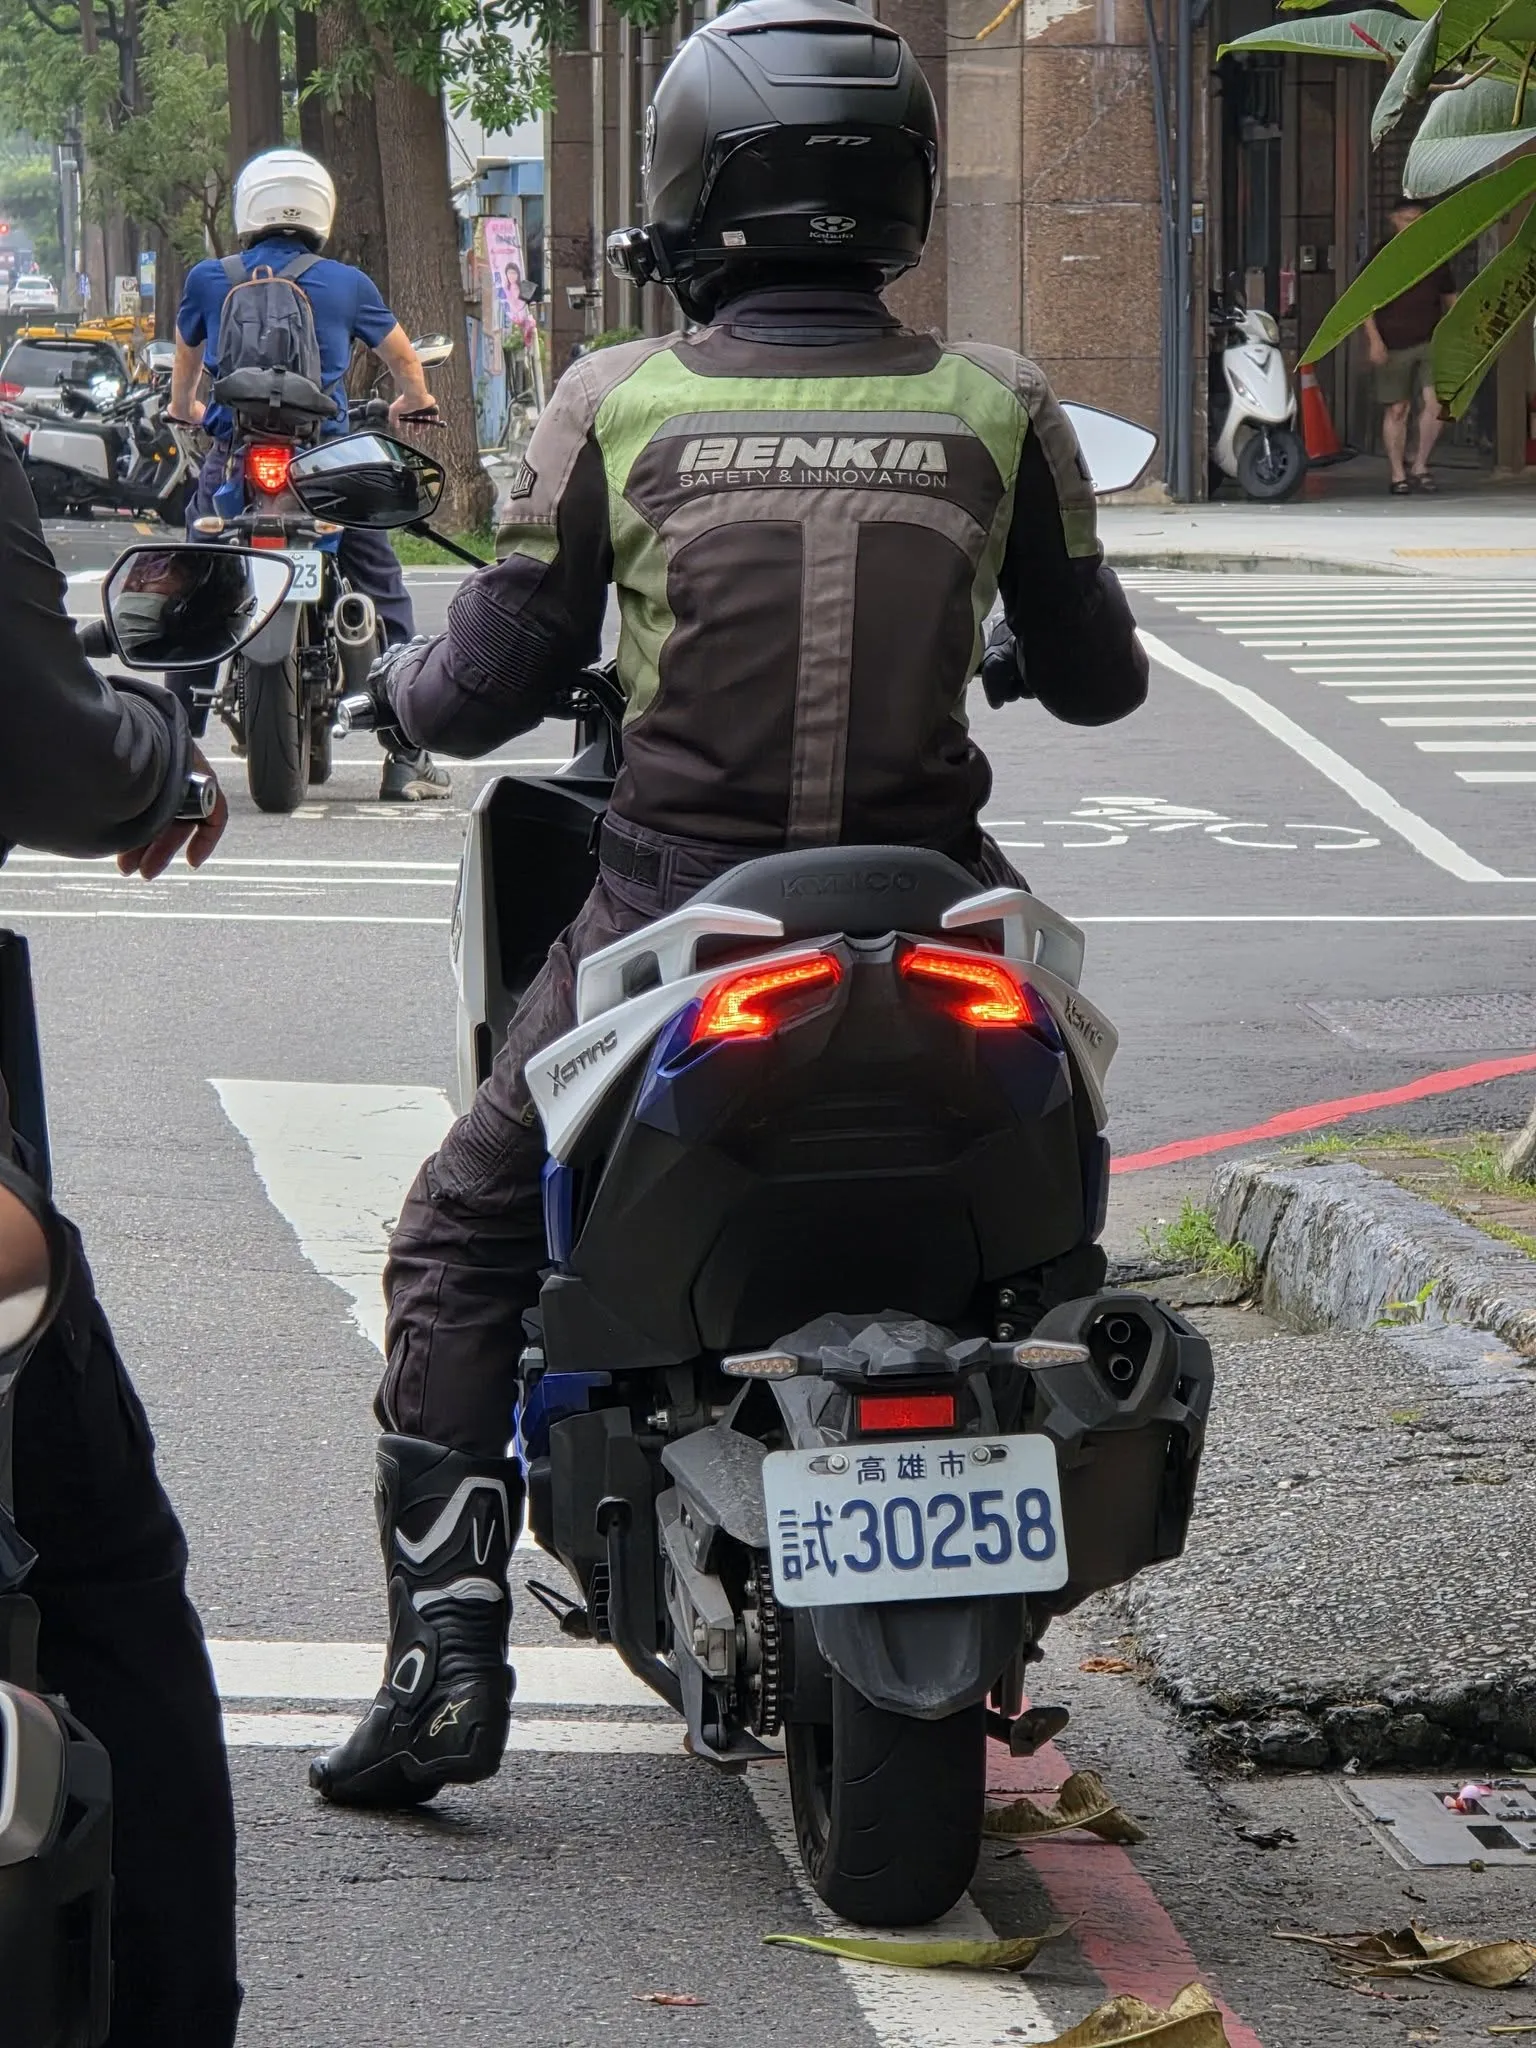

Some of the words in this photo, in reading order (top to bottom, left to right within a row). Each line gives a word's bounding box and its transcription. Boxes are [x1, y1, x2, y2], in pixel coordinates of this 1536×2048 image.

[677, 437, 948, 473] BENKIA
[679, 470, 770, 488] SAFETY
[780, 470, 793, 483] &
[801, 469, 947, 488] INNOVATION
[856, 1449, 966, 1483] 高雄市
[778, 1487, 1057, 1581] 試30258
